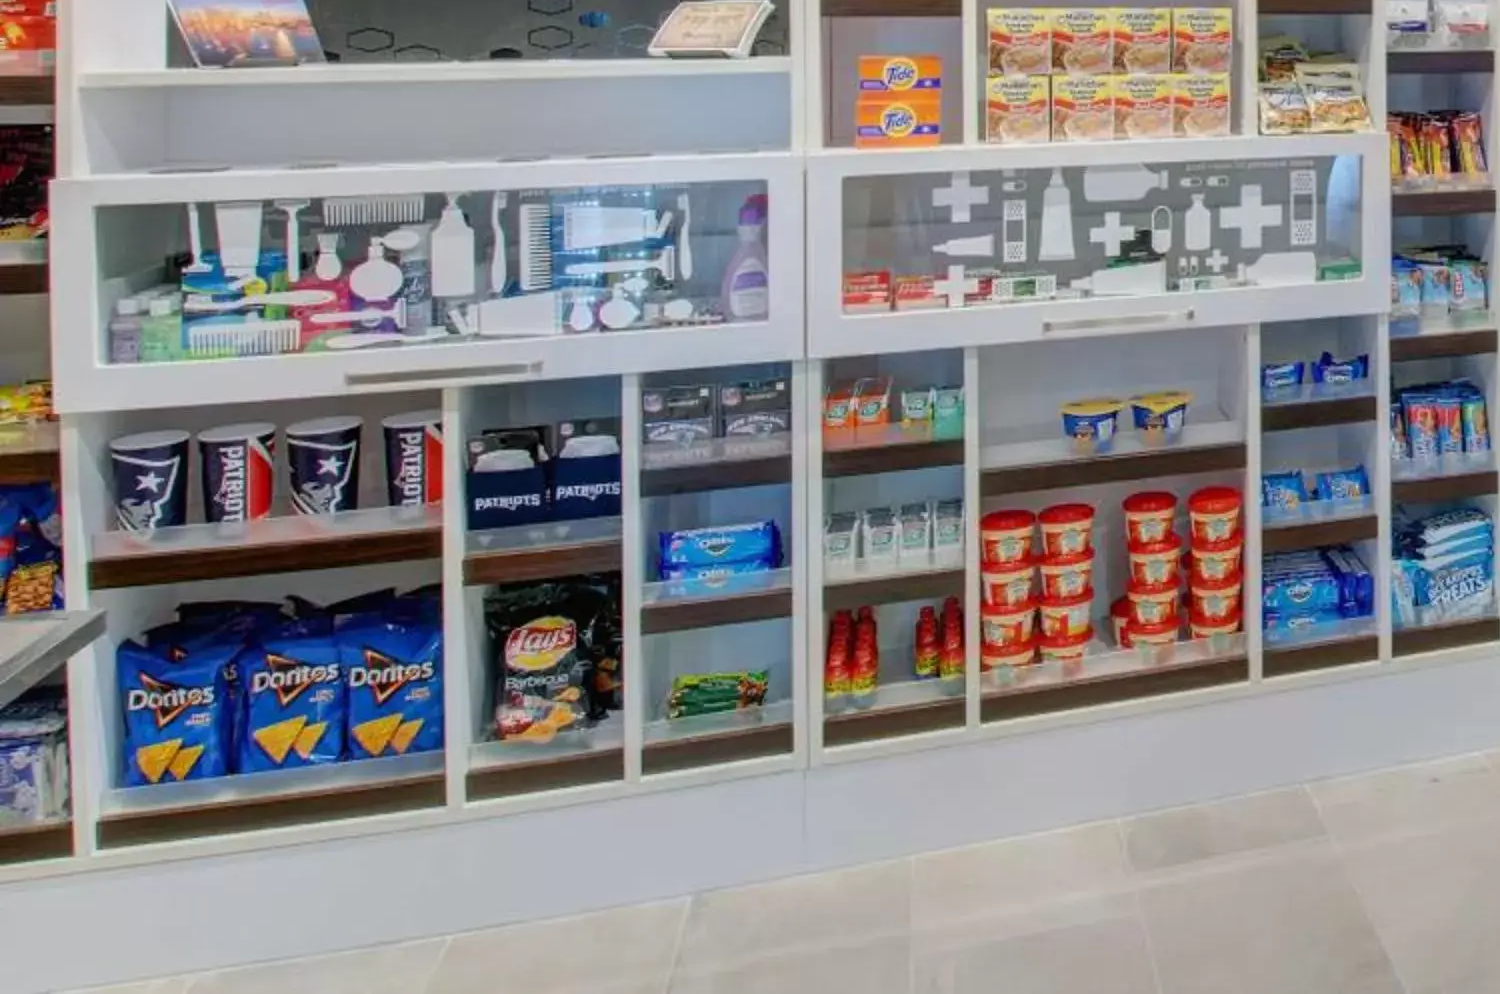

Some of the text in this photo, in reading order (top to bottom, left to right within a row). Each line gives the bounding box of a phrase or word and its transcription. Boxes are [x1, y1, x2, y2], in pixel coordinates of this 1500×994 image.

[475, 493, 541, 511] PATRIOTS
[555, 481, 621, 501] PATRIOTS
[252, 661, 340, 693] Doritos
[349, 660, 434, 687] Doritos
[127, 685, 214, 711] Doritos
